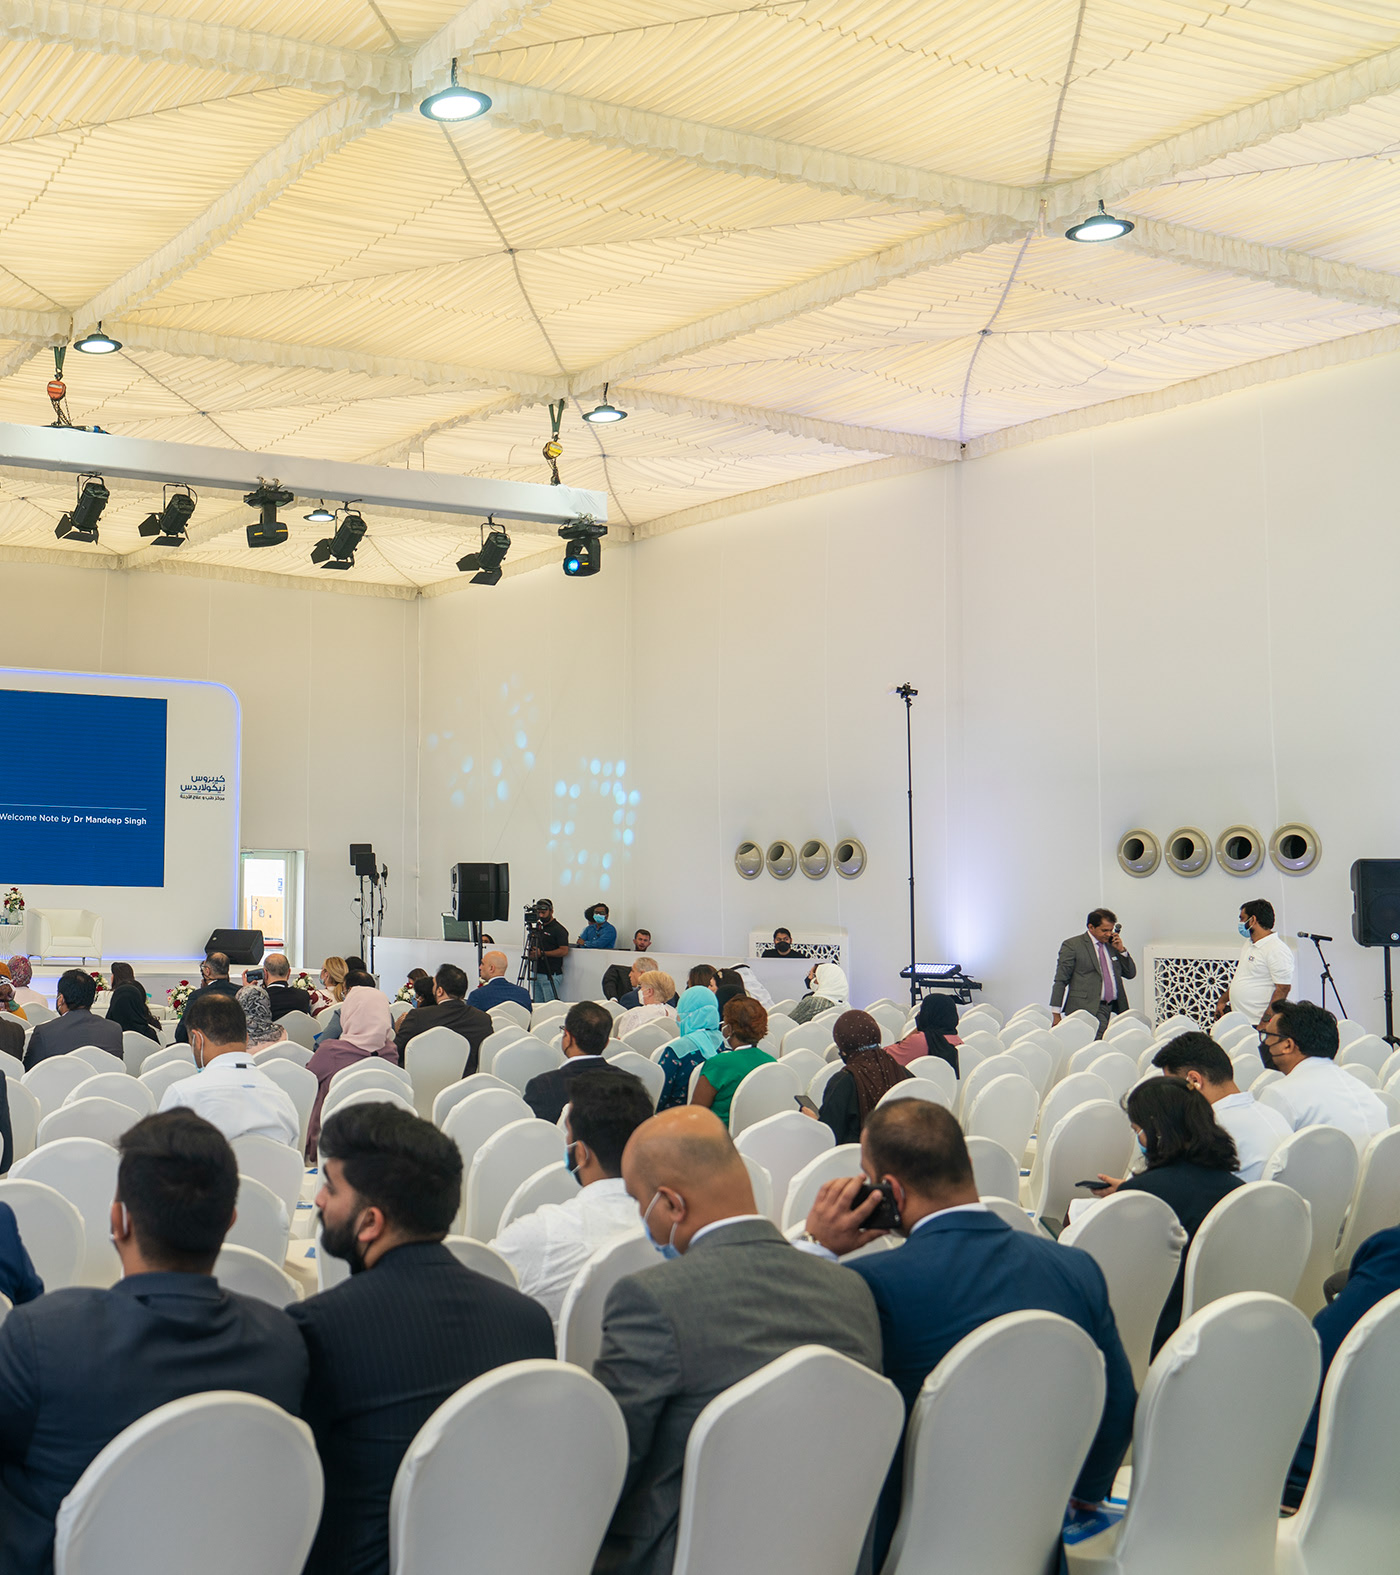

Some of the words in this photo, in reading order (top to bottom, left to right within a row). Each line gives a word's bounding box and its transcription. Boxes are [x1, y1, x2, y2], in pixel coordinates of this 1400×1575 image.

[62, 815, 71, 824] by
[86, 816, 122, 825] Mandeep
[124, 817, 146, 826] Singh
